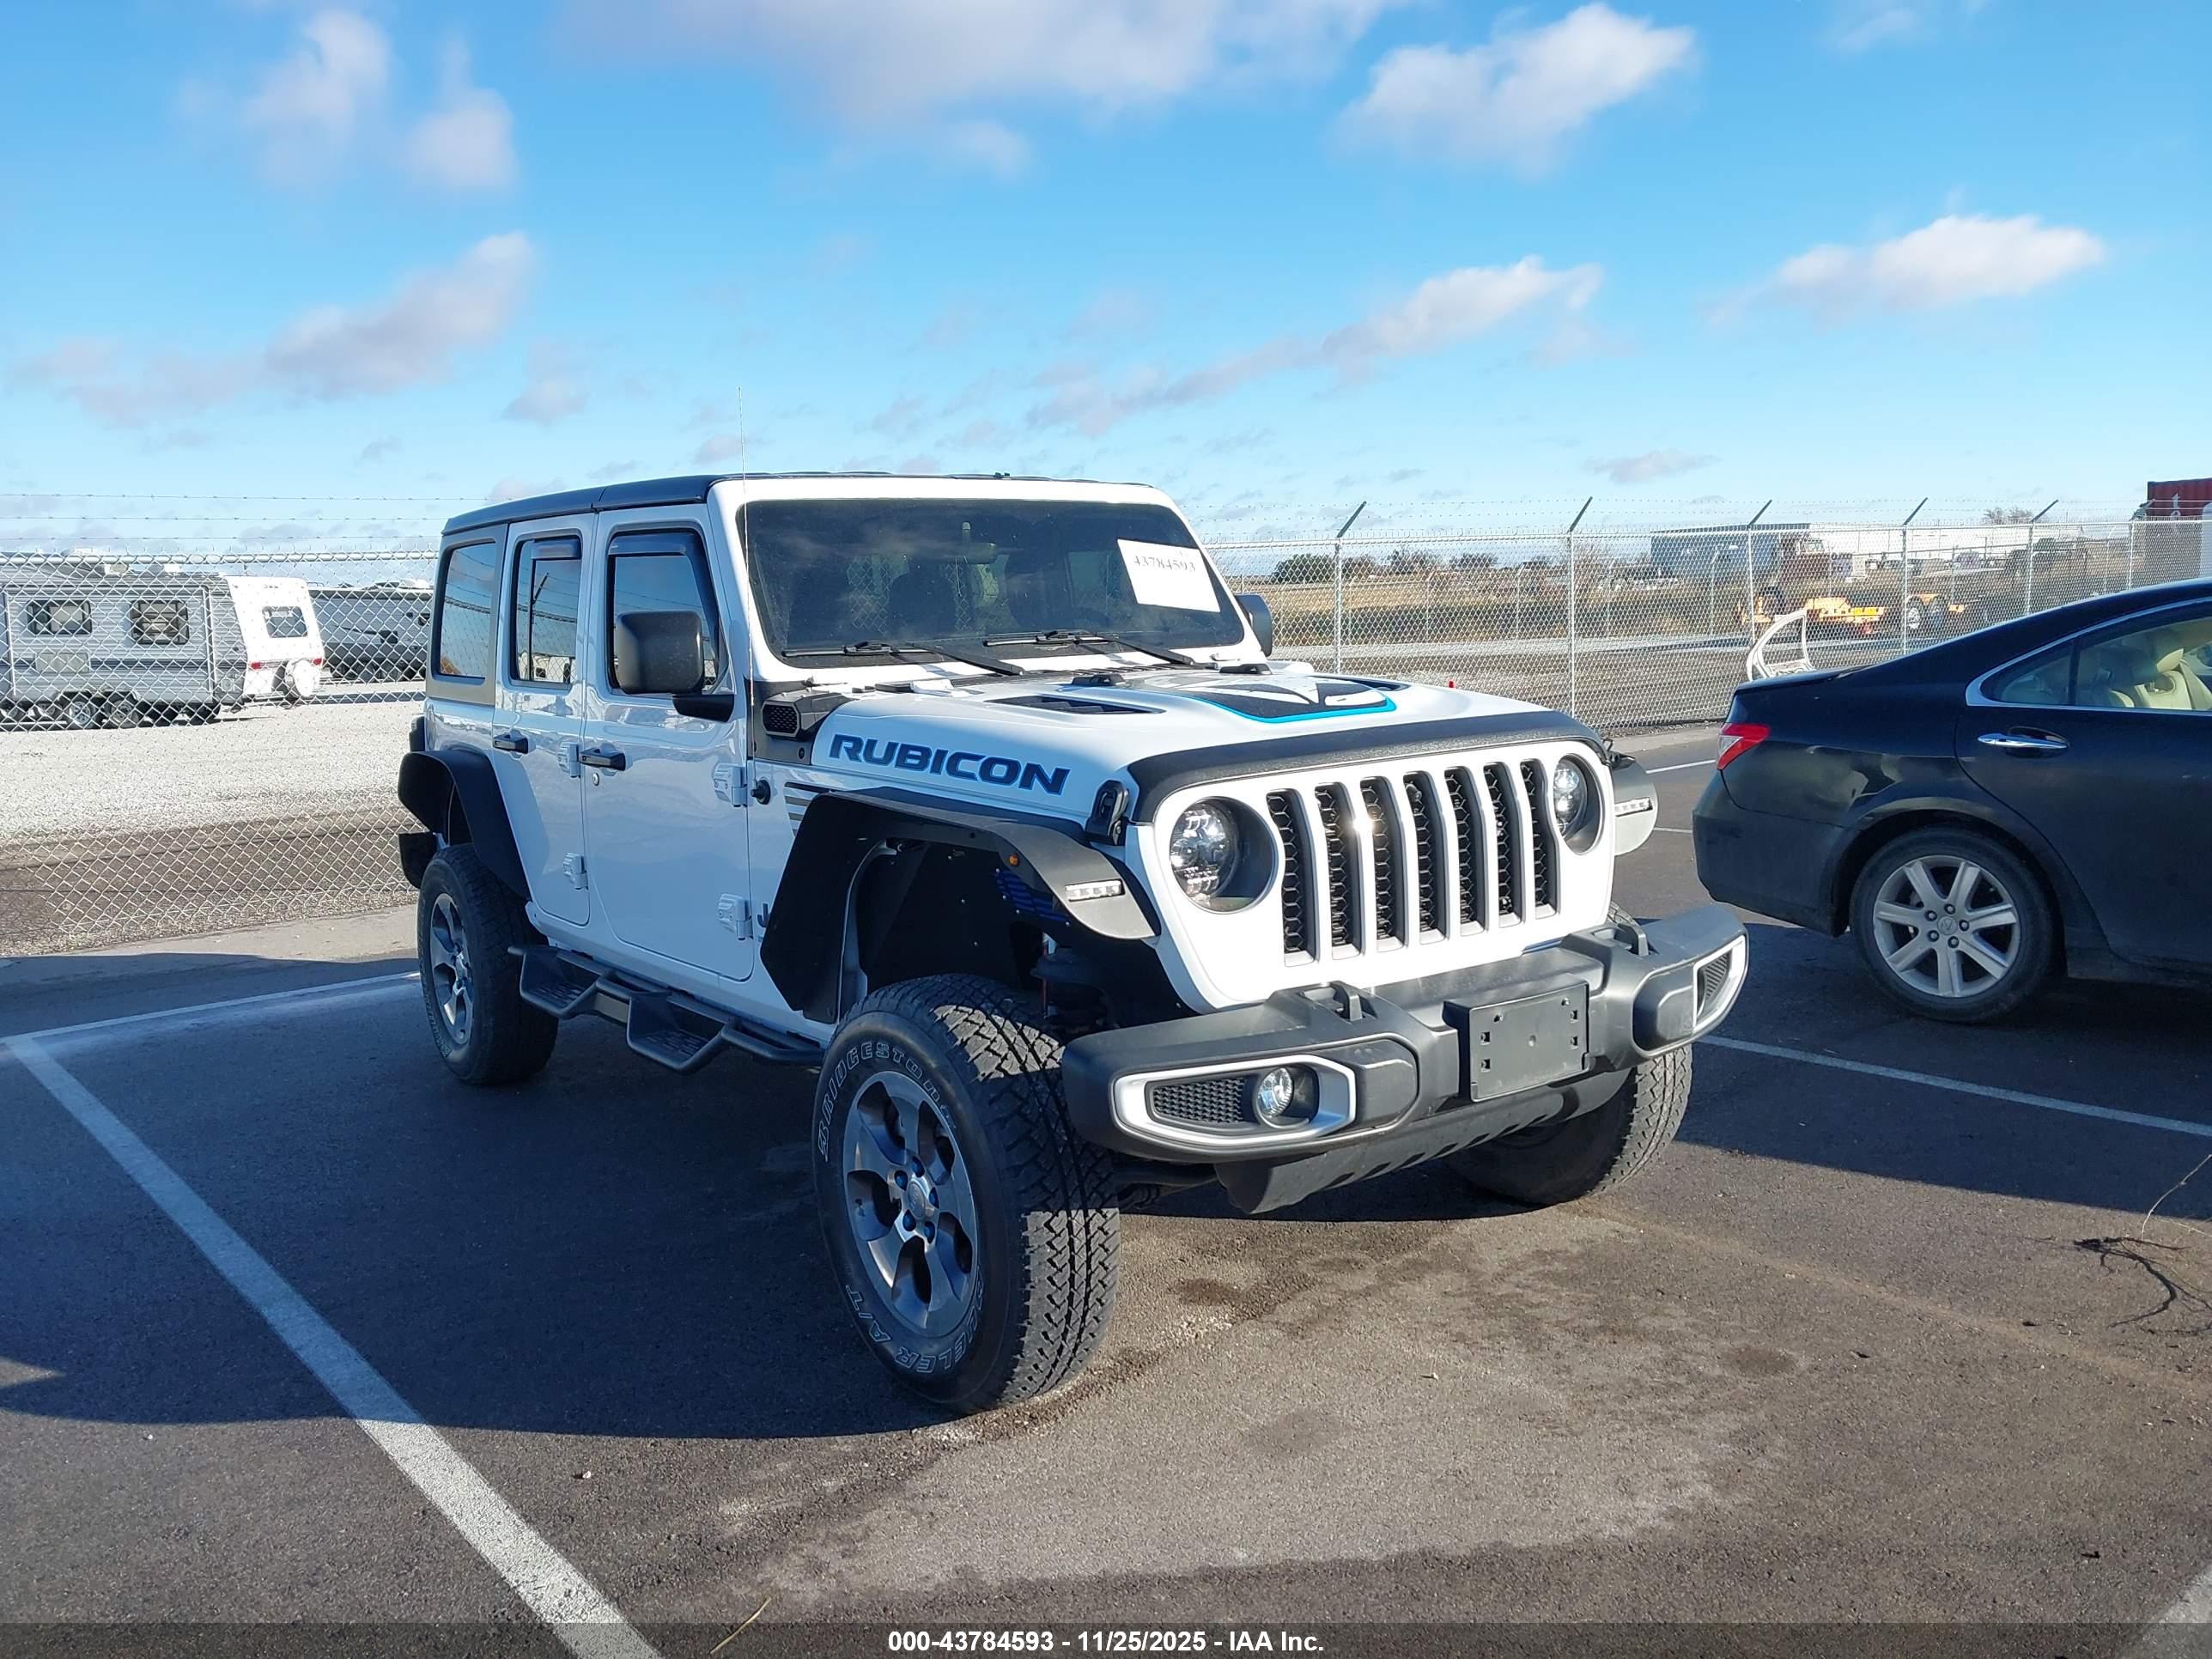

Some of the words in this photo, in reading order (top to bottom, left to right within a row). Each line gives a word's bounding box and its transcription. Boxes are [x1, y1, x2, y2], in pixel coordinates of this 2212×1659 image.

[1133, 556, 1196, 572] 43784593
[829, 733, 1071, 796] RUBICON
[845, 1285, 891, 1342] A/T
